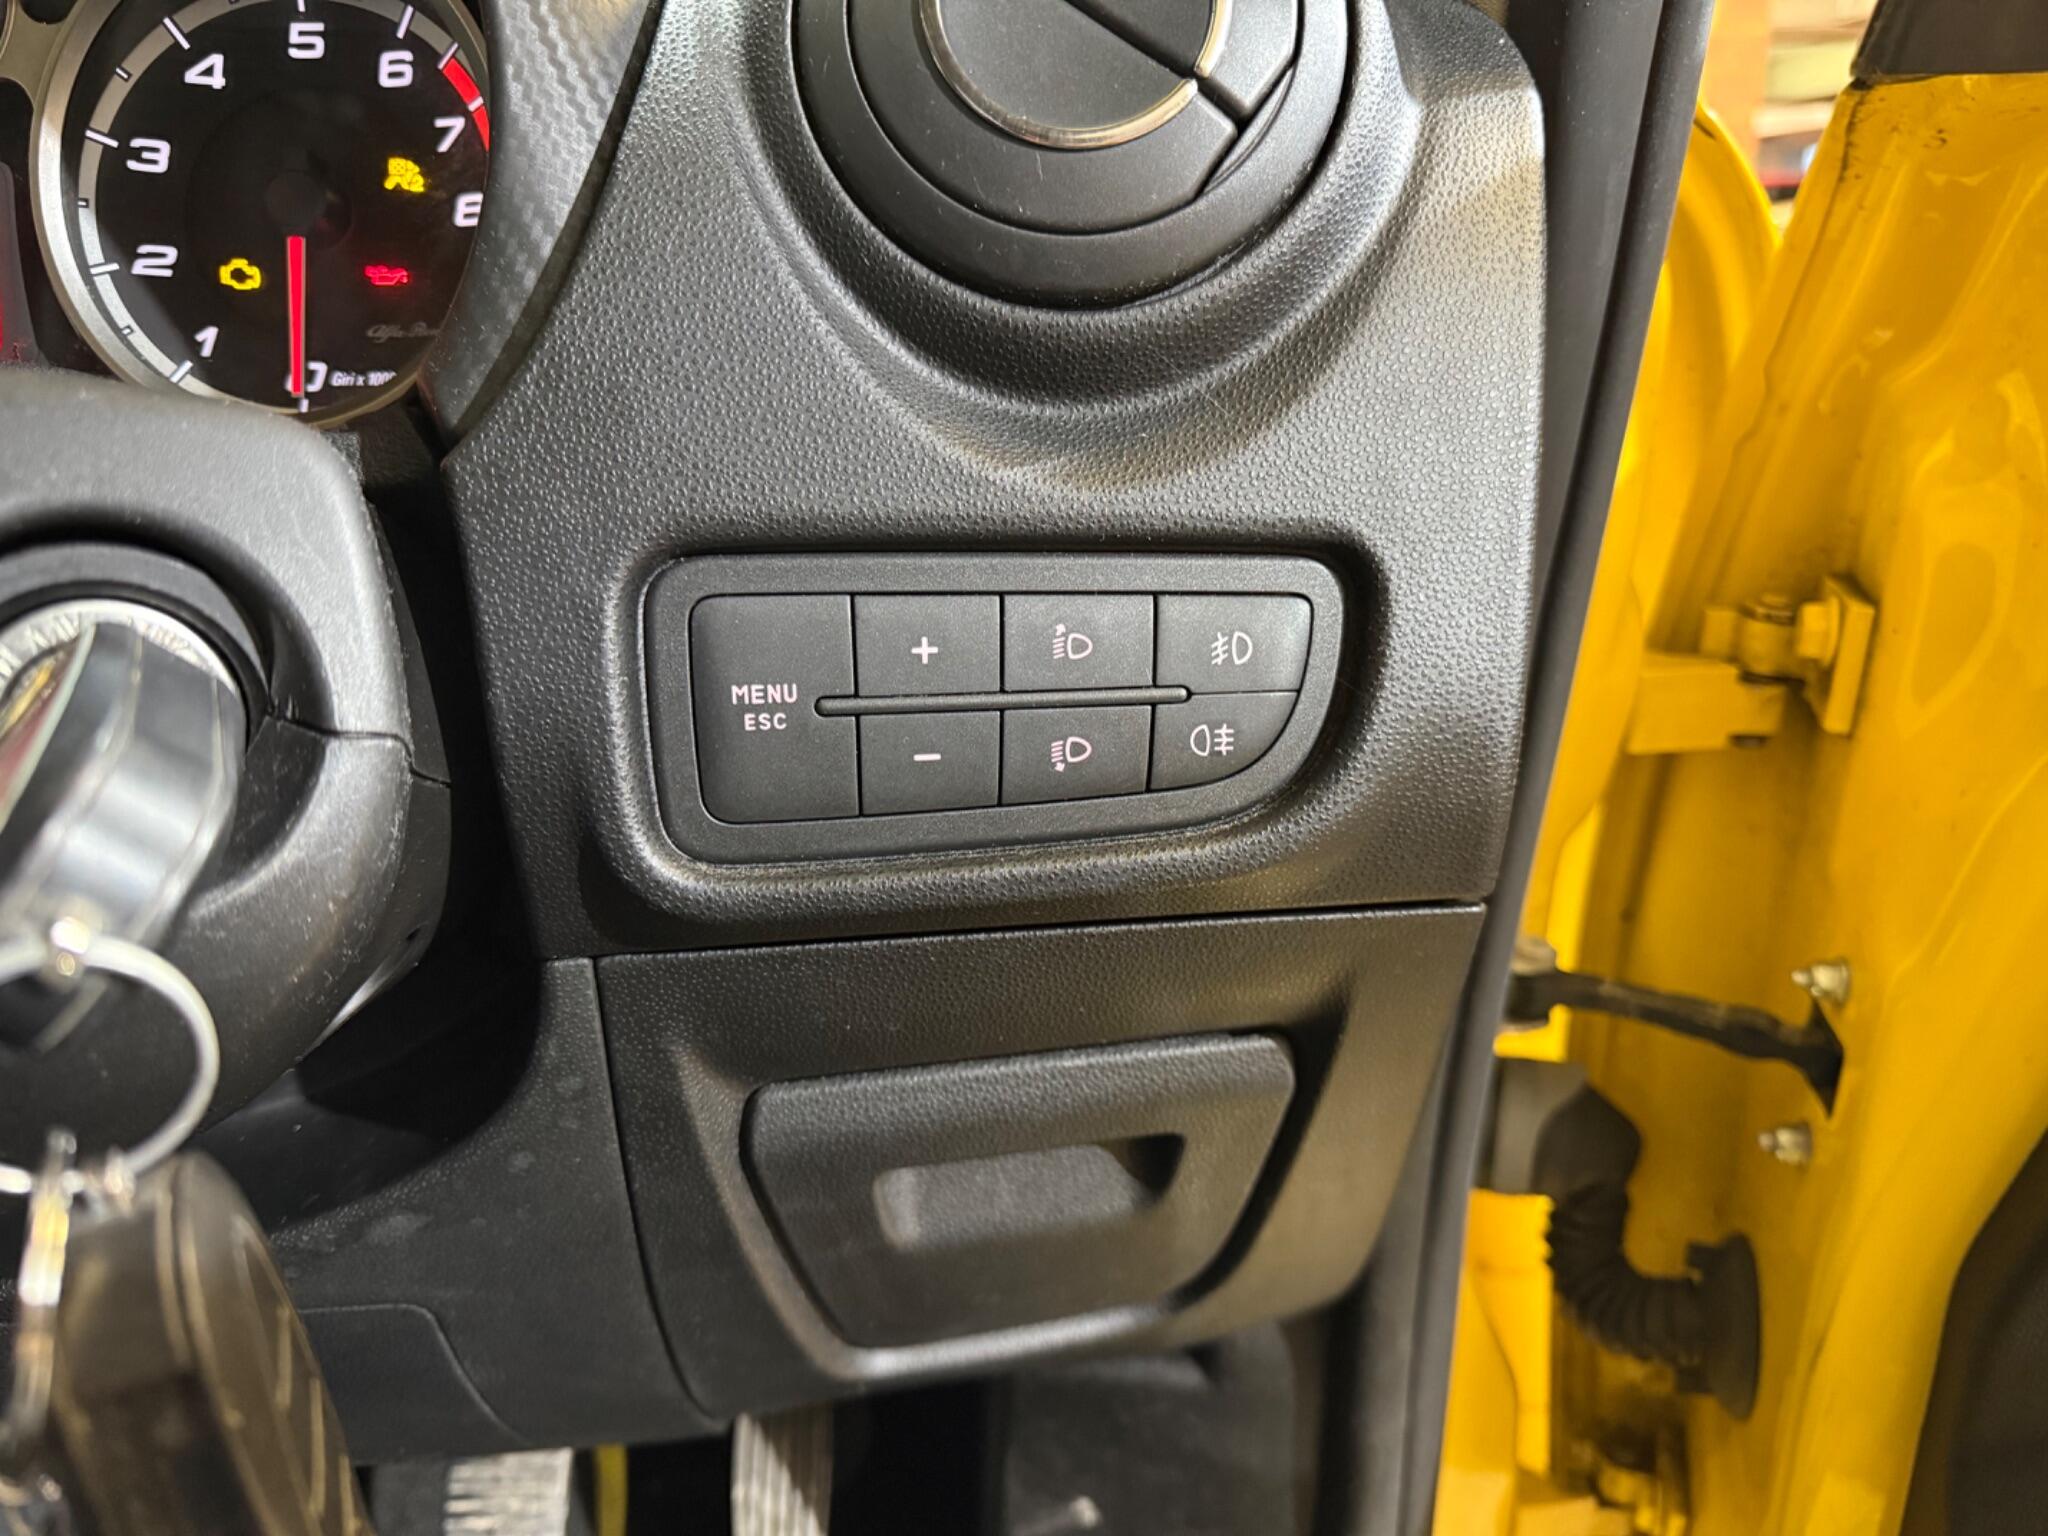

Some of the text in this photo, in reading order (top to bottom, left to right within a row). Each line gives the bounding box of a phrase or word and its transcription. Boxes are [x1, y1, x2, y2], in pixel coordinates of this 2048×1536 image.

[287, 22, 325, 59] 5
[183, 53, 226, 89] 4
[378, 50, 414, 88] 6
[433, 116, 465, 153] 7
[126, 137, 171, 173] 3
[131, 244, 178, 277] 2
[194, 326, 219, 358] 1
[731, 683, 798, 705] MENU
[743, 712, 787, 731] ESC
